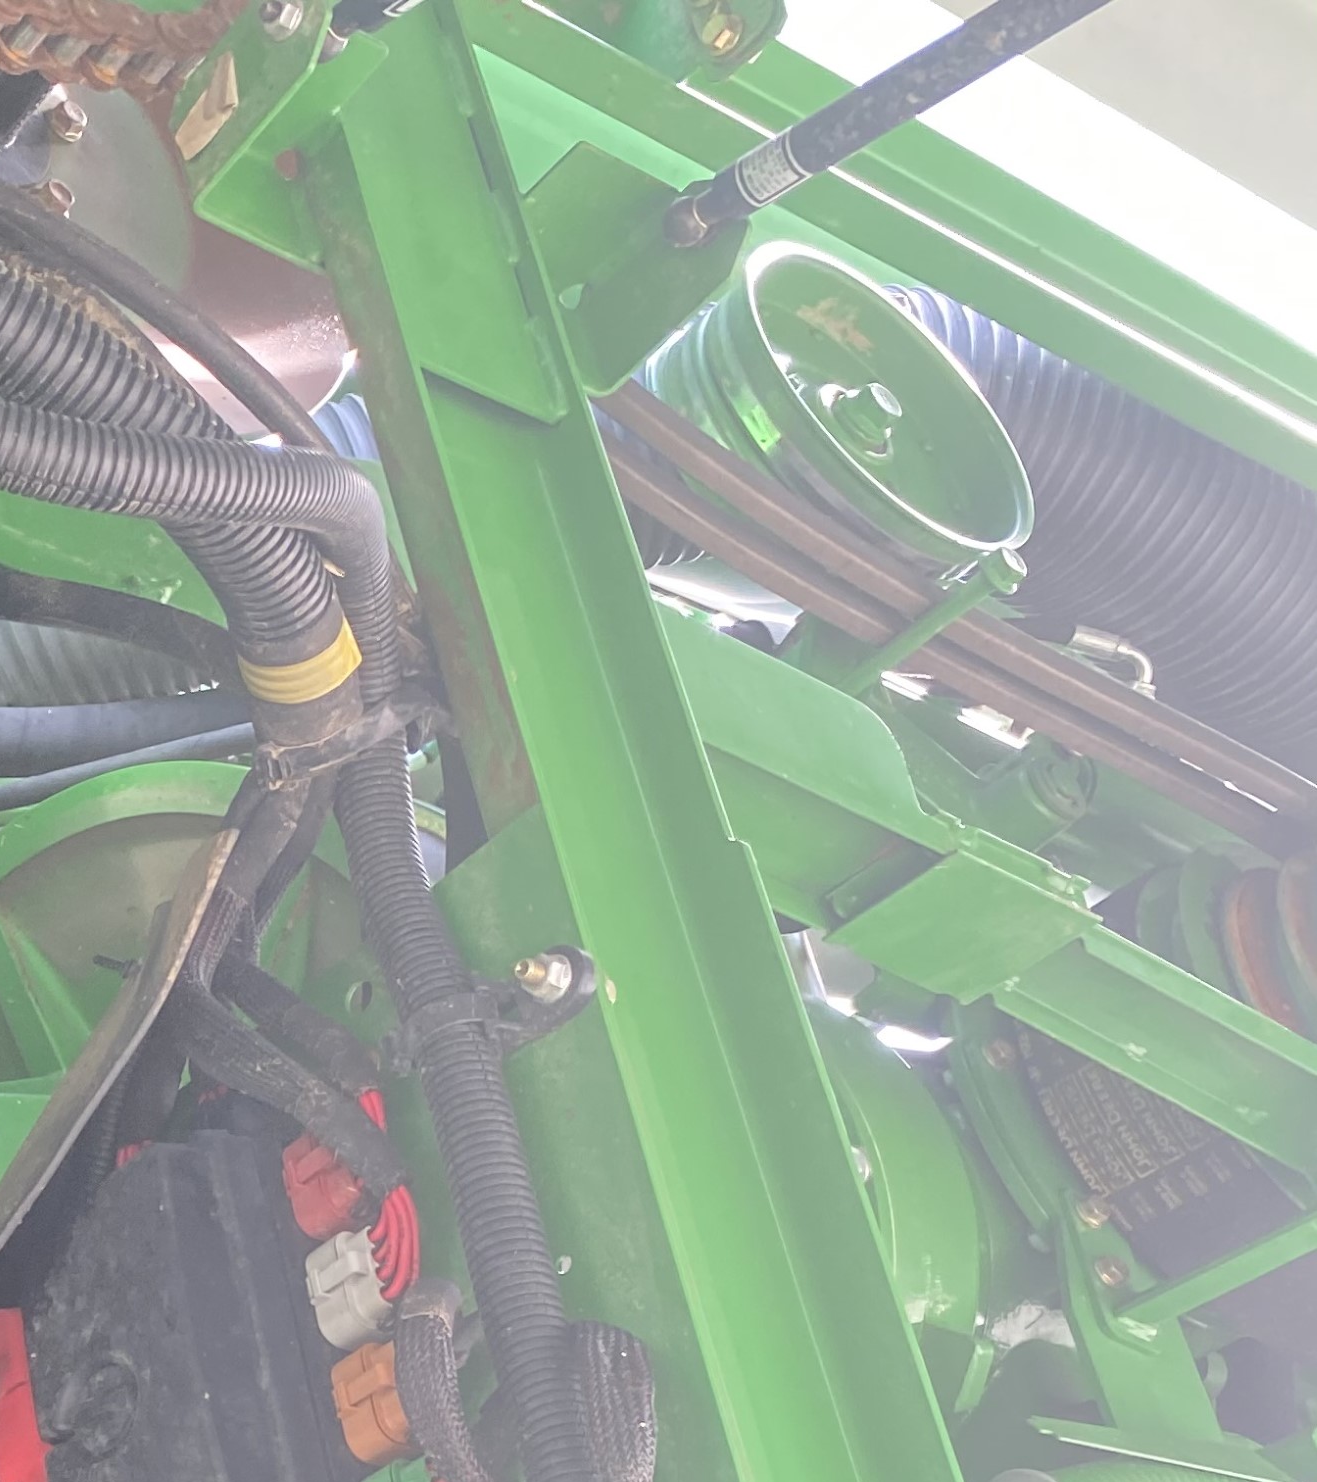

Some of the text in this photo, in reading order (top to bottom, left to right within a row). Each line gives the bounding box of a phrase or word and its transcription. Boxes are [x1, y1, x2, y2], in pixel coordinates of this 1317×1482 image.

[1085, 1067, 1124, 1126] DEERE
[1115, 1123, 1153, 1167] JOHN
[1141, 1110, 1178, 1153] JOHN
[1067, 1148, 1104, 1194] JOHN
